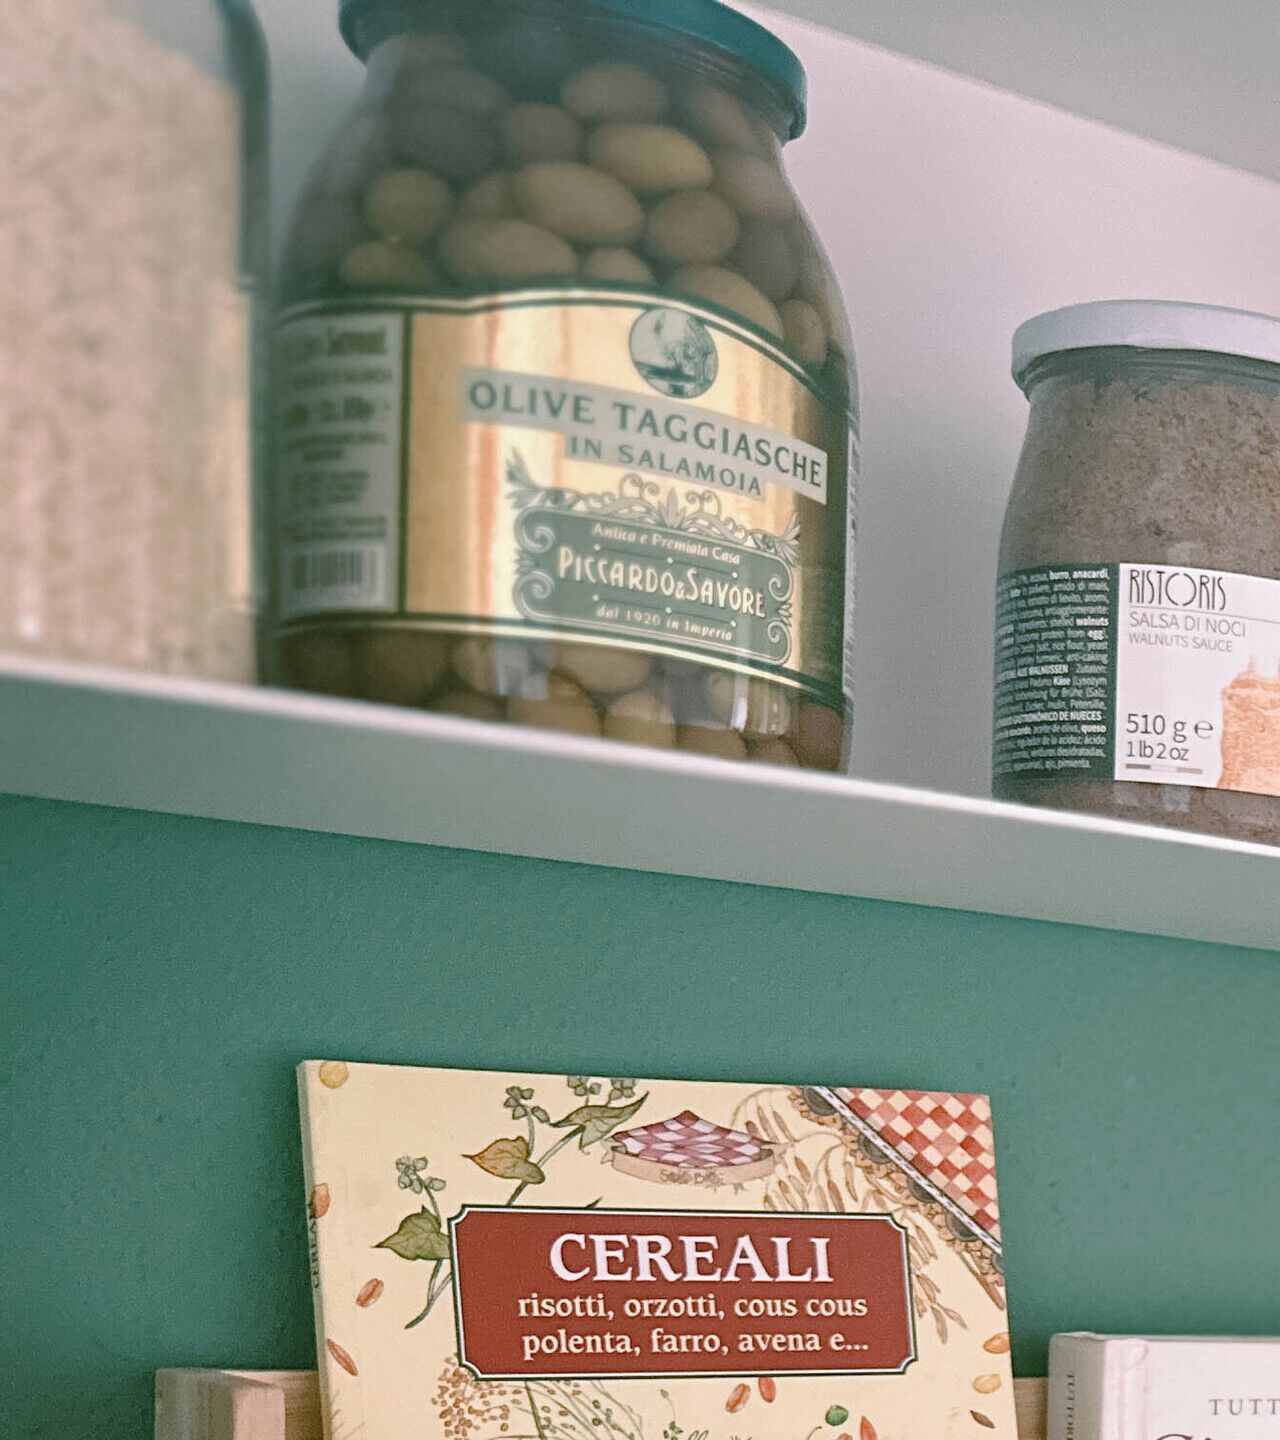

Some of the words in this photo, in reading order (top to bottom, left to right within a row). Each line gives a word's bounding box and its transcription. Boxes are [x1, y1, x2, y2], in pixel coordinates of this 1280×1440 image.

[469, 381, 594, 424] OLIVE
[613, 401, 822, 488] TAGGIASCHE
[570, 436, 601, 459] IN
[618, 444, 762, 496] SALAMOIA
[592, 523, 636, 542] Antica
[640, 534, 650, 544] e
[712, 547, 742, 565] Casa
[1130, 569, 1227, 612] RISTORIS
[596, 606, 619, 620] dal
[626, 609, 662, 627] 1920
[667, 618, 679, 630] in
[685, 620, 733, 641] Imperia
[1075, 616, 1109, 627] walnuts
[1129, 611, 1180, 629] SALSA
[1184, 617, 1200, 632] DI
[1206, 619, 1246, 638] NOCI
[1128, 631, 1190, 649] WALNUTS
[1191, 636, 1233, 654] SAUCE
[1059, 711, 1070, 720] DE
[1070, 711, 1102, 720] NUECES
[1126, 713, 1166, 736] 510
[1173, 720, 1188, 743] g
[549, 1232, 834, 1283] CEREALI
[518, 1292, 615, 1320] risotti,
[624, 1293, 726, 1320] orzotti,
[734, 1297, 798, 1318] cous
[805, 1297, 868, 1317] cous
[522, 1328, 641, 1361] polenta,
[650, 1327, 730, 1355] farro,
[738, 1332, 823, 1352] avena
[829, 1332, 870, 1352] e...
